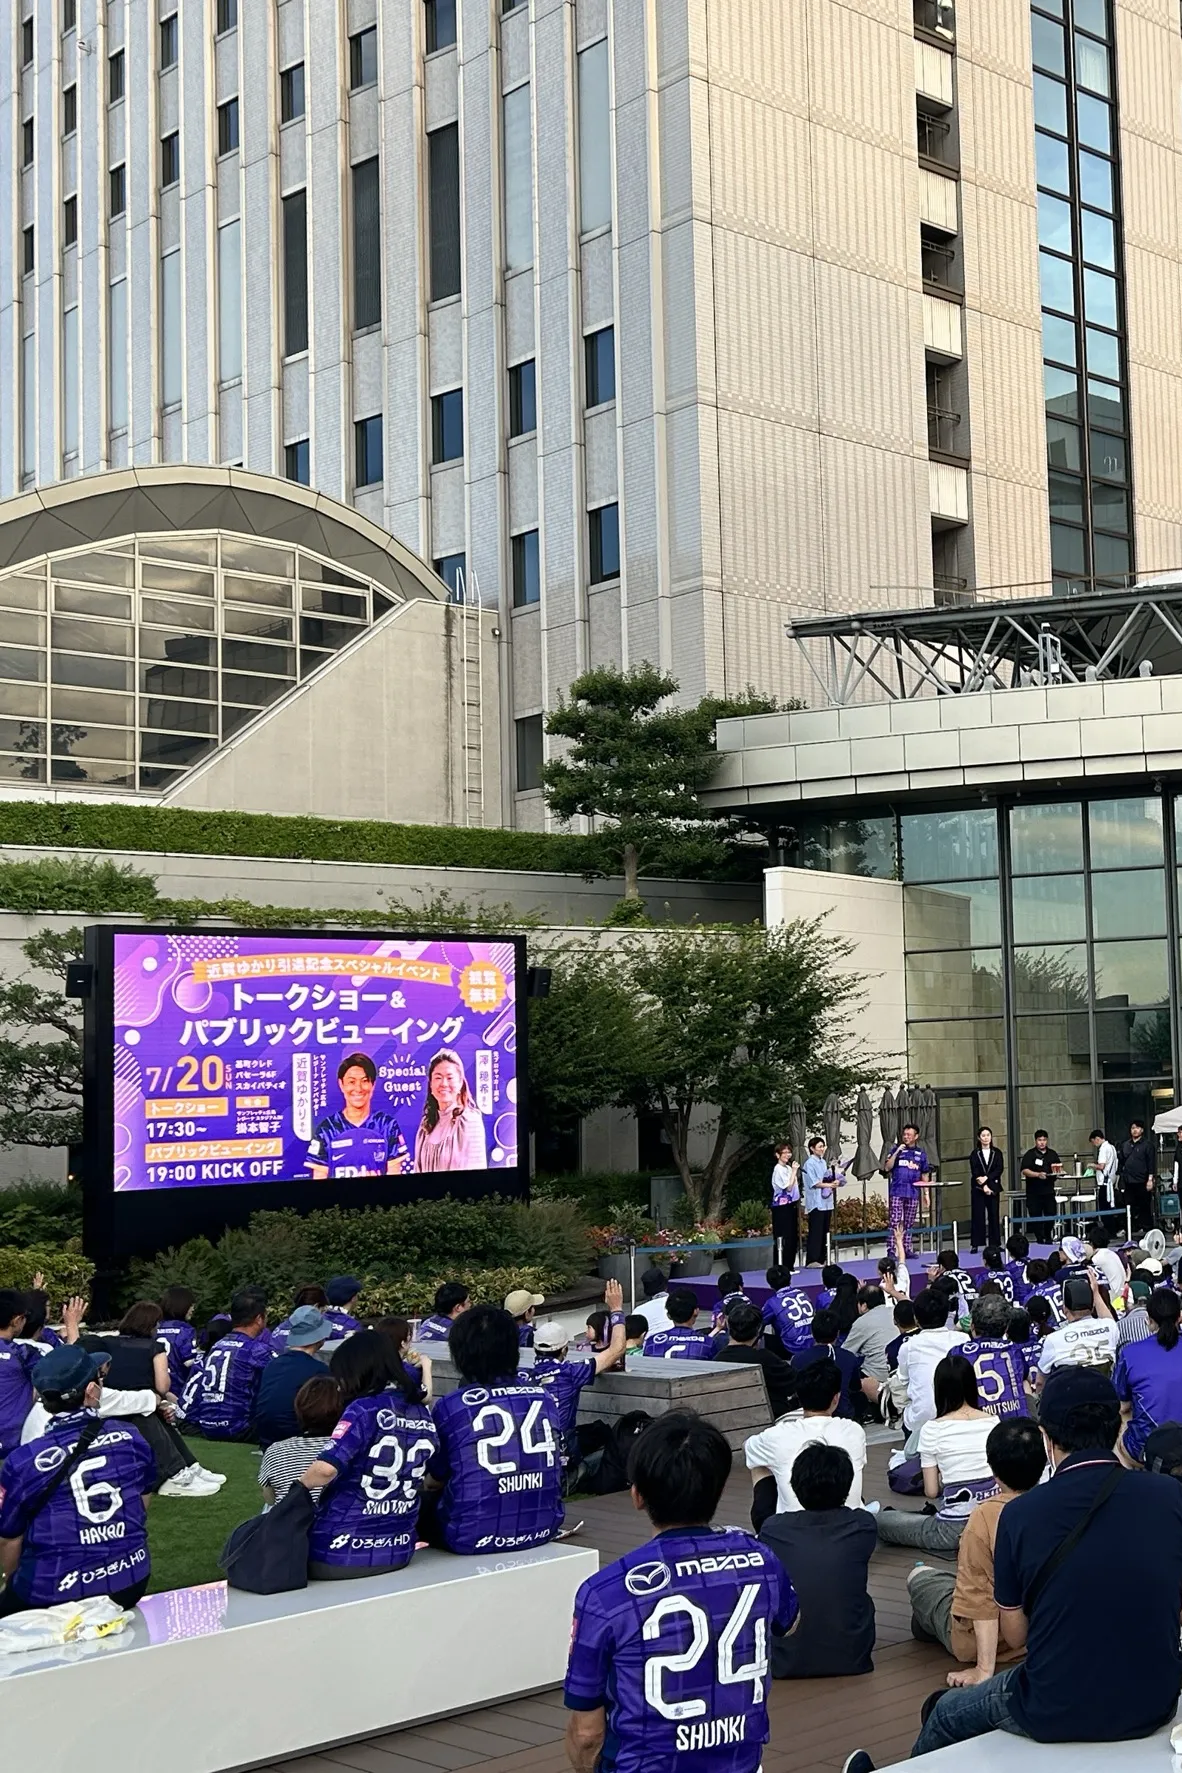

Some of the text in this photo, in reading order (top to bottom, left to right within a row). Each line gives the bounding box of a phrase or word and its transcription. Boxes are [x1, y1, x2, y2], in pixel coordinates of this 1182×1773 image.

[207, 957, 441, 981] 近賀ゆかり引退記念スペシャルイベント
[233, 982, 407, 1012] トークショー&
[179, 1015, 465, 1047] パブリックビューイング
[145, 1055, 224, 1092] 7/20
[378, 1065, 427, 1078] Special
[384, 1081, 422, 1092] Guest
[149, 1141, 277, 1159] パブリックビューイング
[146, 1160, 284, 1182] 19:00 KICK OFF
[491, 1386, 545, 1397] mazda
[472, 1400, 556, 1475] 24
[69, 1455, 123, 1524] 6
[498, 1472, 543, 1494] SHUNKI
[675, 1552, 765, 1577] mazda
[642, 1583, 769, 1720] 24
[675, 1714, 746, 1751] SHUNKI
